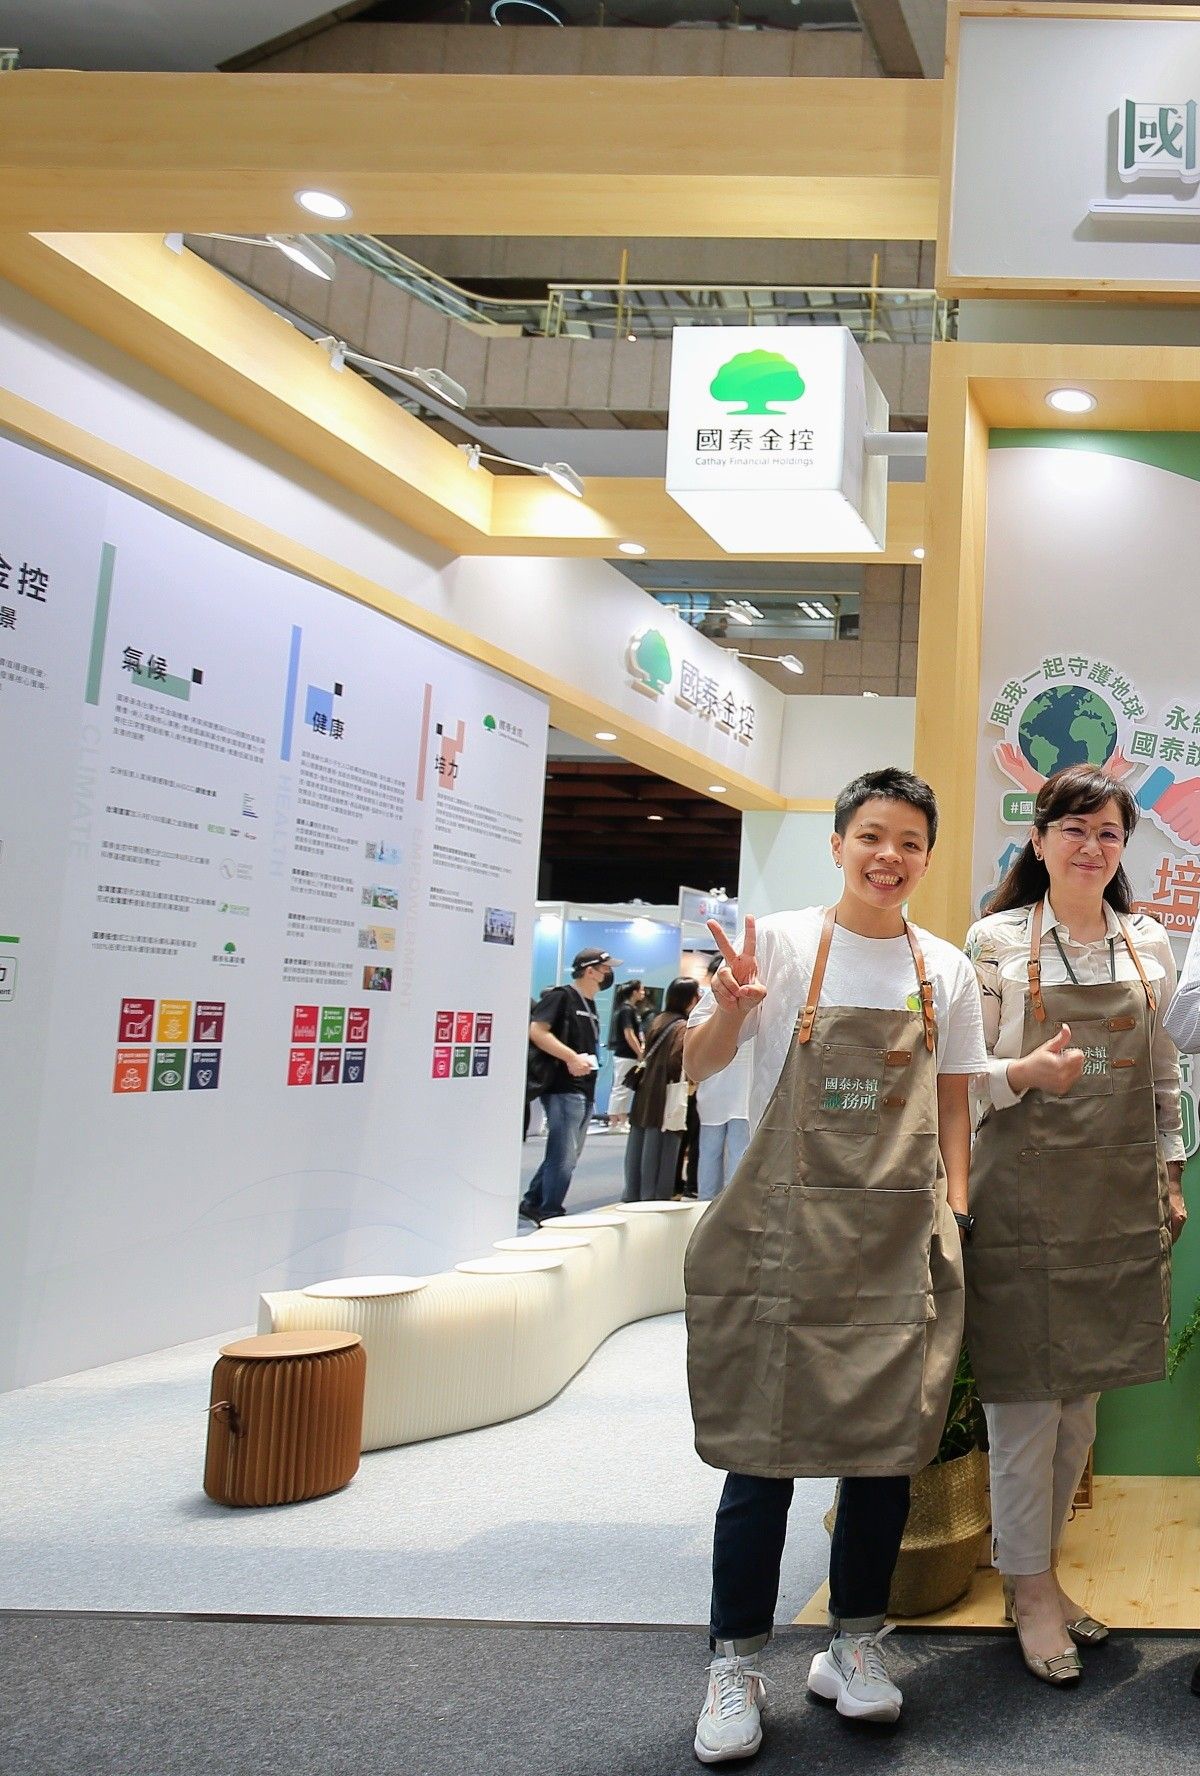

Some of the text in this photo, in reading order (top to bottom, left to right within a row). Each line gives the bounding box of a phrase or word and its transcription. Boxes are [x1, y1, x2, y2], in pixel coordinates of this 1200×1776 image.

[696, 428, 814, 452] 國泰金控
[695, 457, 814, 467] Cathay Financial Holdings
[122, 646, 168, 682] 氣候
[680, 659, 755, 741] 國泰金控
[990, 656, 1145, 726] 跟我一起守護地球
[312, 711, 345, 740] 健康
[434, 754, 459, 779] 培力
[1010, 801, 1033, 815] #國
[824, 1077, 878, 1092] 國泰永續
